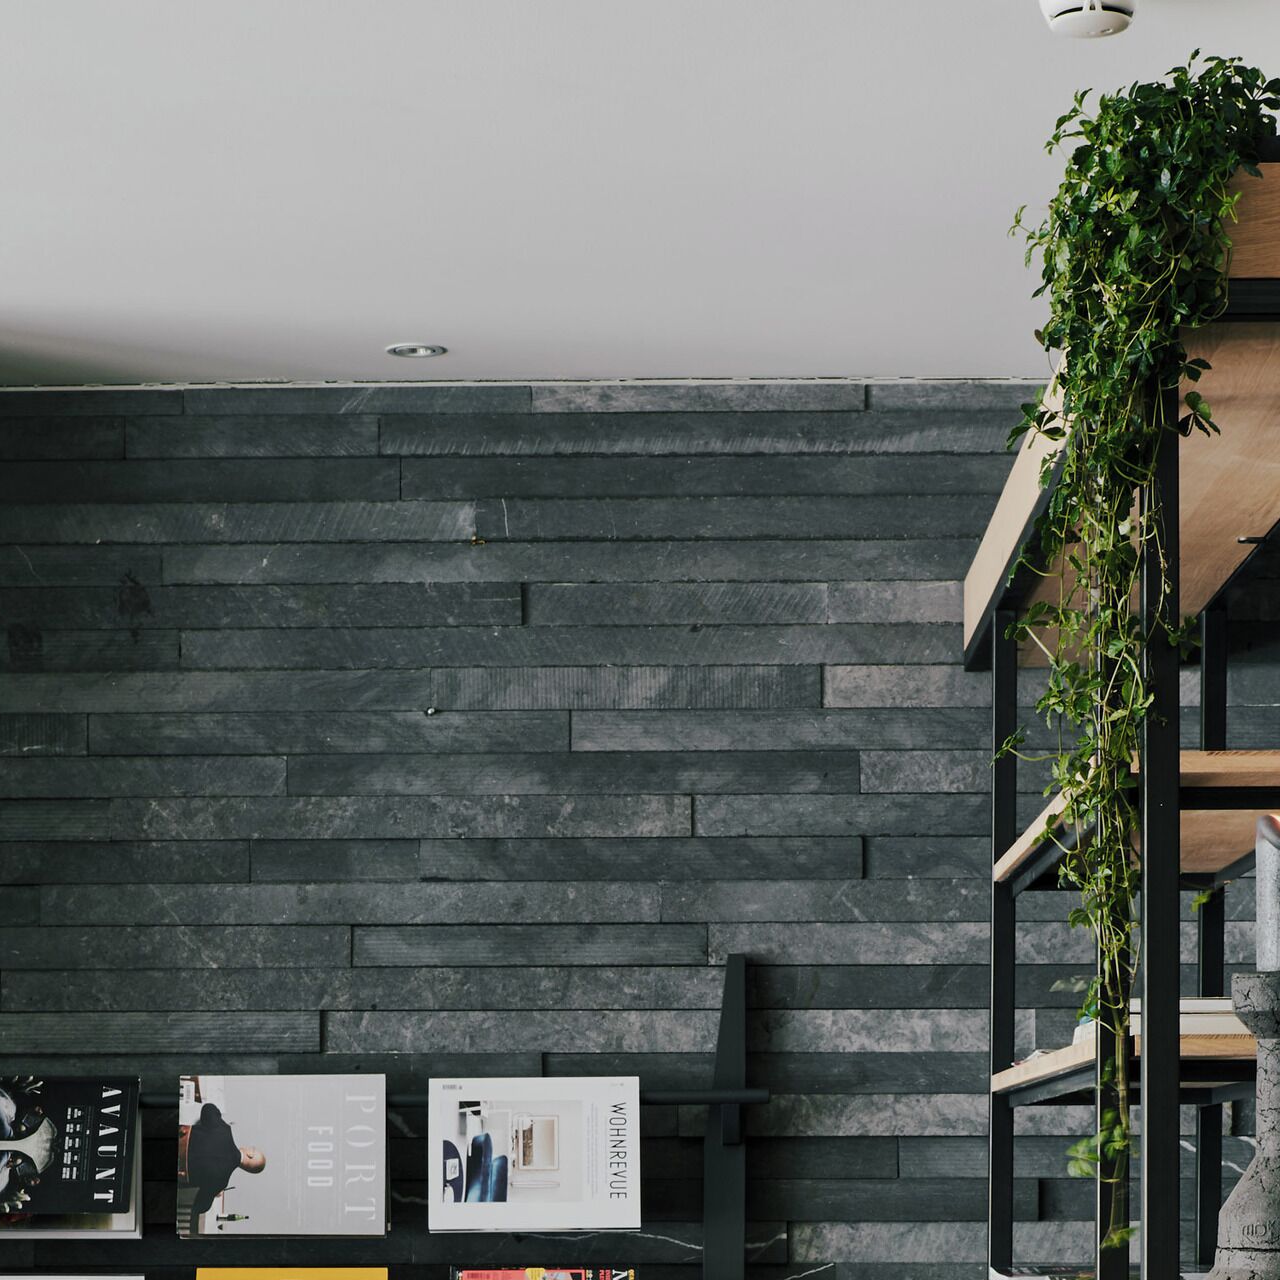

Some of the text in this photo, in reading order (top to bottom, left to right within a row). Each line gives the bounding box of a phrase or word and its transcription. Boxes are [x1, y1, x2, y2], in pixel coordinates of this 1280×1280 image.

[94, 1085, 123, 1204] AVAUNT
[307, 1125, 334, 1188] FOOD
[343, 1092, 377, 1221] PORT
[609, 1102, 627, 1200] WOHNREVUE
